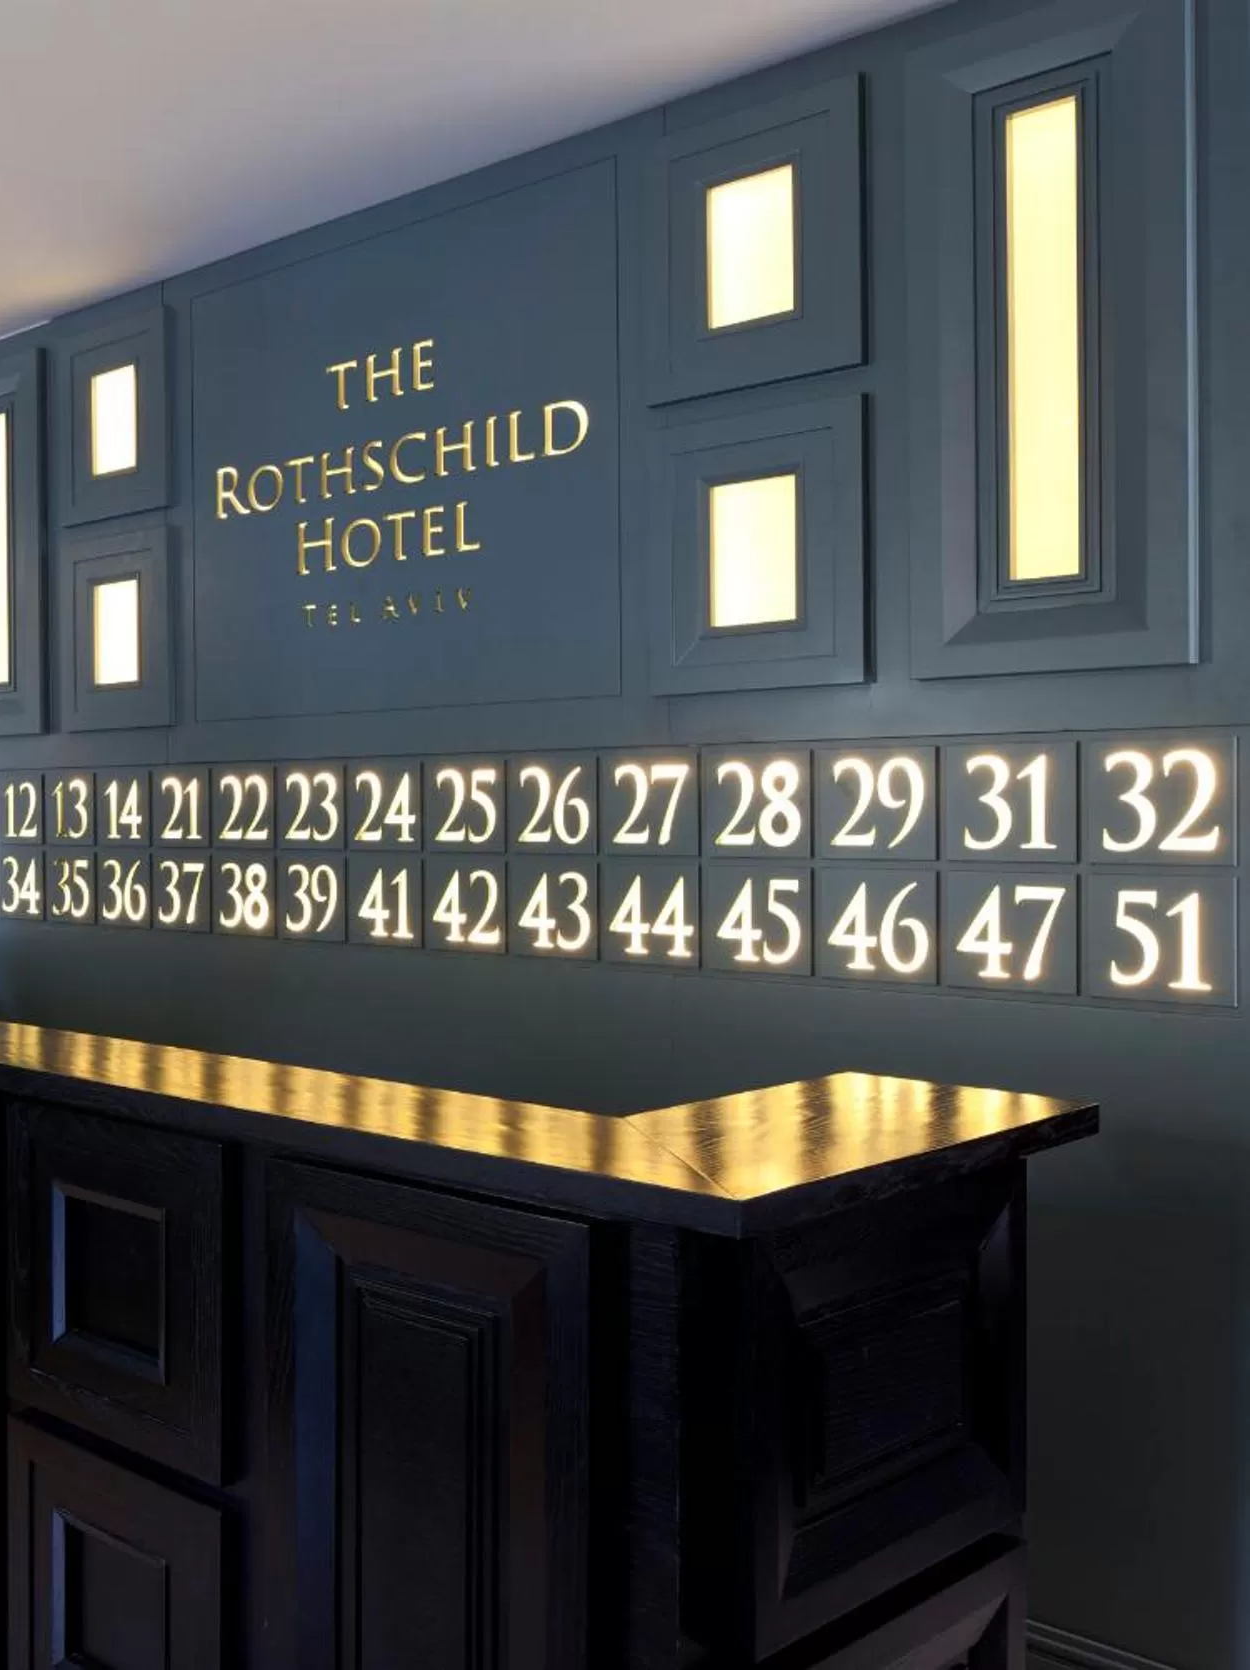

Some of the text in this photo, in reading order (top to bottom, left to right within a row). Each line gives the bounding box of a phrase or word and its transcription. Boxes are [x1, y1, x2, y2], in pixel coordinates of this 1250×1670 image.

[326, 339, 434, 409] THE
[216, 399, 590, 519] ROTHSCHILD
[296, 500, 481, 575] HOTEL
[302, 587, 471, 627] TEL AVIV
[6, 782, 37, 837] 12
[54, 779, 87, 838] 13
[105, 780, 142, 838] 14
[162, 777, 201, 839] 21
[220, 774, 268, 839] 22
[286, 772, 338, 841] 23
[355, 771, 415, 841] 24
[436, 768, 496, 843] 25
[519, 766, 589, 844] 26
[614, 761, 690, 844] 27
[716, 758, 801, 847] 28
[831, 755, 926, 848] 29
[965, 752, 1057, 850] 31
[1103, 746, 1220, 852] 32
[2, 857, 40, 914] 34
[53, 860, 89, 917] 35
[103, 860, 146, 921] 36
[159, 861, 204, 923] 37
[220, 863, 269, 930] 38
[287, 865, 337, 932] 39
[359, 869, 413, 939] 41
[433, 870, 500, 945] 42
[519, 872, 590, 951] 43
[610, 876, 694, 957] 44
[717, 879, 801, 965] 45
[828, 882, 929, 974] 46
[956, 885, 1065, 981] 47
[1110, 890, 1212, 991] 51
